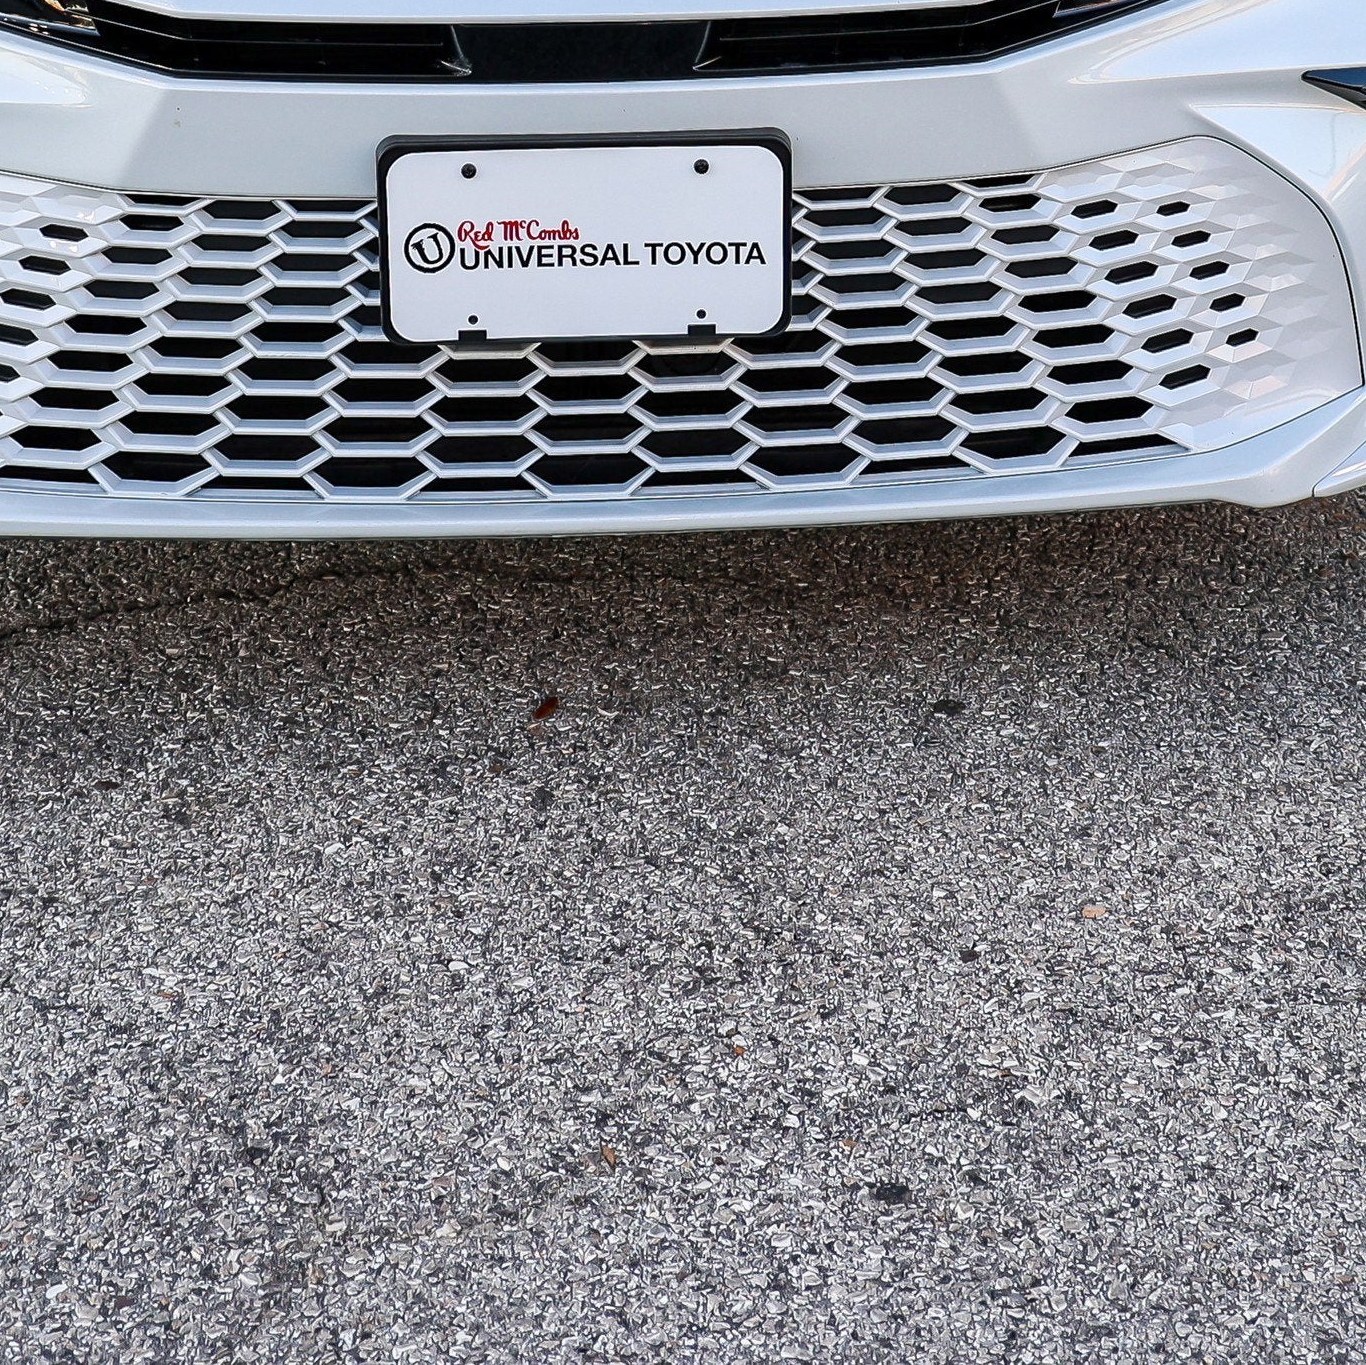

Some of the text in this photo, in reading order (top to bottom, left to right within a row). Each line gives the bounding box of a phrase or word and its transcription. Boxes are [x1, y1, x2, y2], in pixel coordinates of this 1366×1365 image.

[457, 219, 580, 250] Red McCombs
[459, 241, 767, 271] UNIVERSAL TOYOTA
